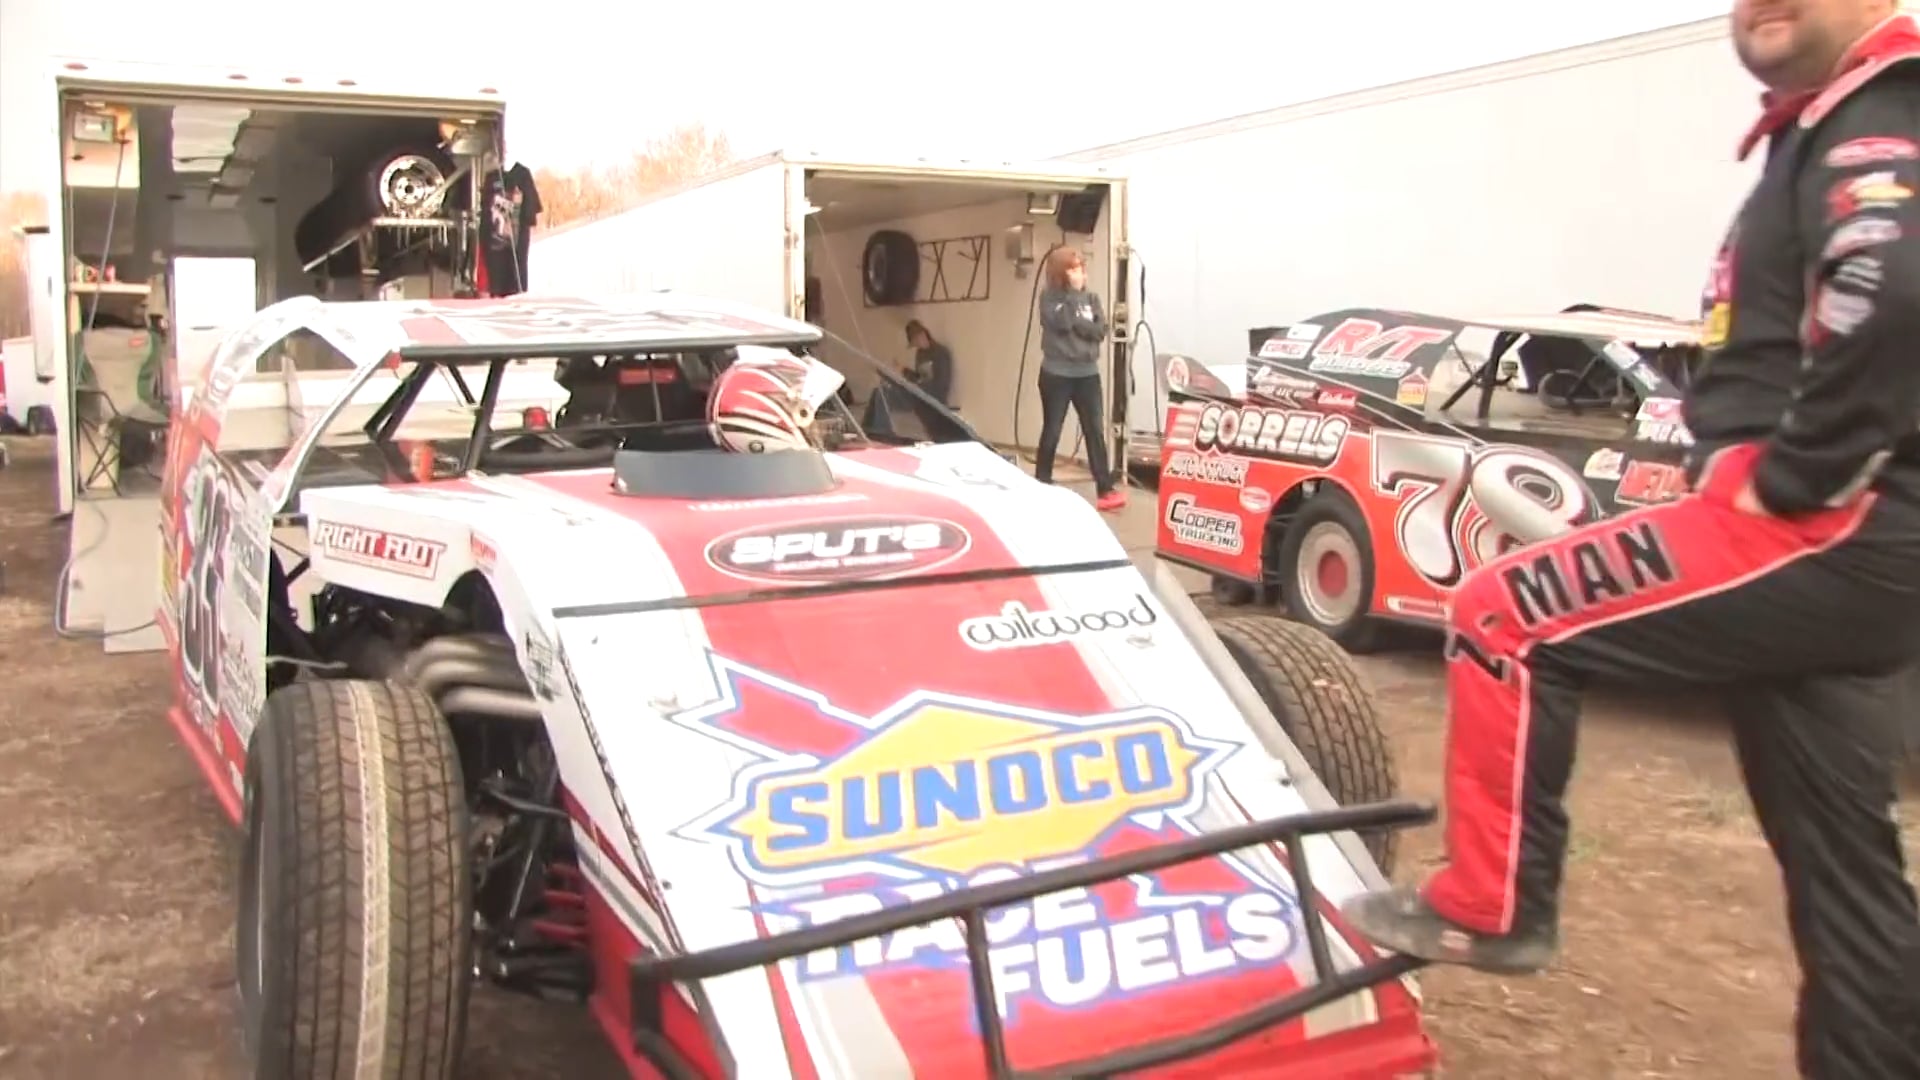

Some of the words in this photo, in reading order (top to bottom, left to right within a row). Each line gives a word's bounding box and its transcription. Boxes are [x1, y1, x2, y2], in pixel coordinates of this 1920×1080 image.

[1196, 405, 1349, 463] SORRELS
[1169, 498, 1237, 536] COOPER
[1371, 427, 1600, 590] 78
[316, 523, 382, 557] RIGHT
[383, 533, 447, 568] FOOT
[729, 522, 942, 565] SPUT'S
[966, 592, 1157, 645] wilwood
[765, 729, 1173, 852] SUNOCO
[802, 857, 1098, 975] RACE
[983, 893, 1293, 1020] FUELS
